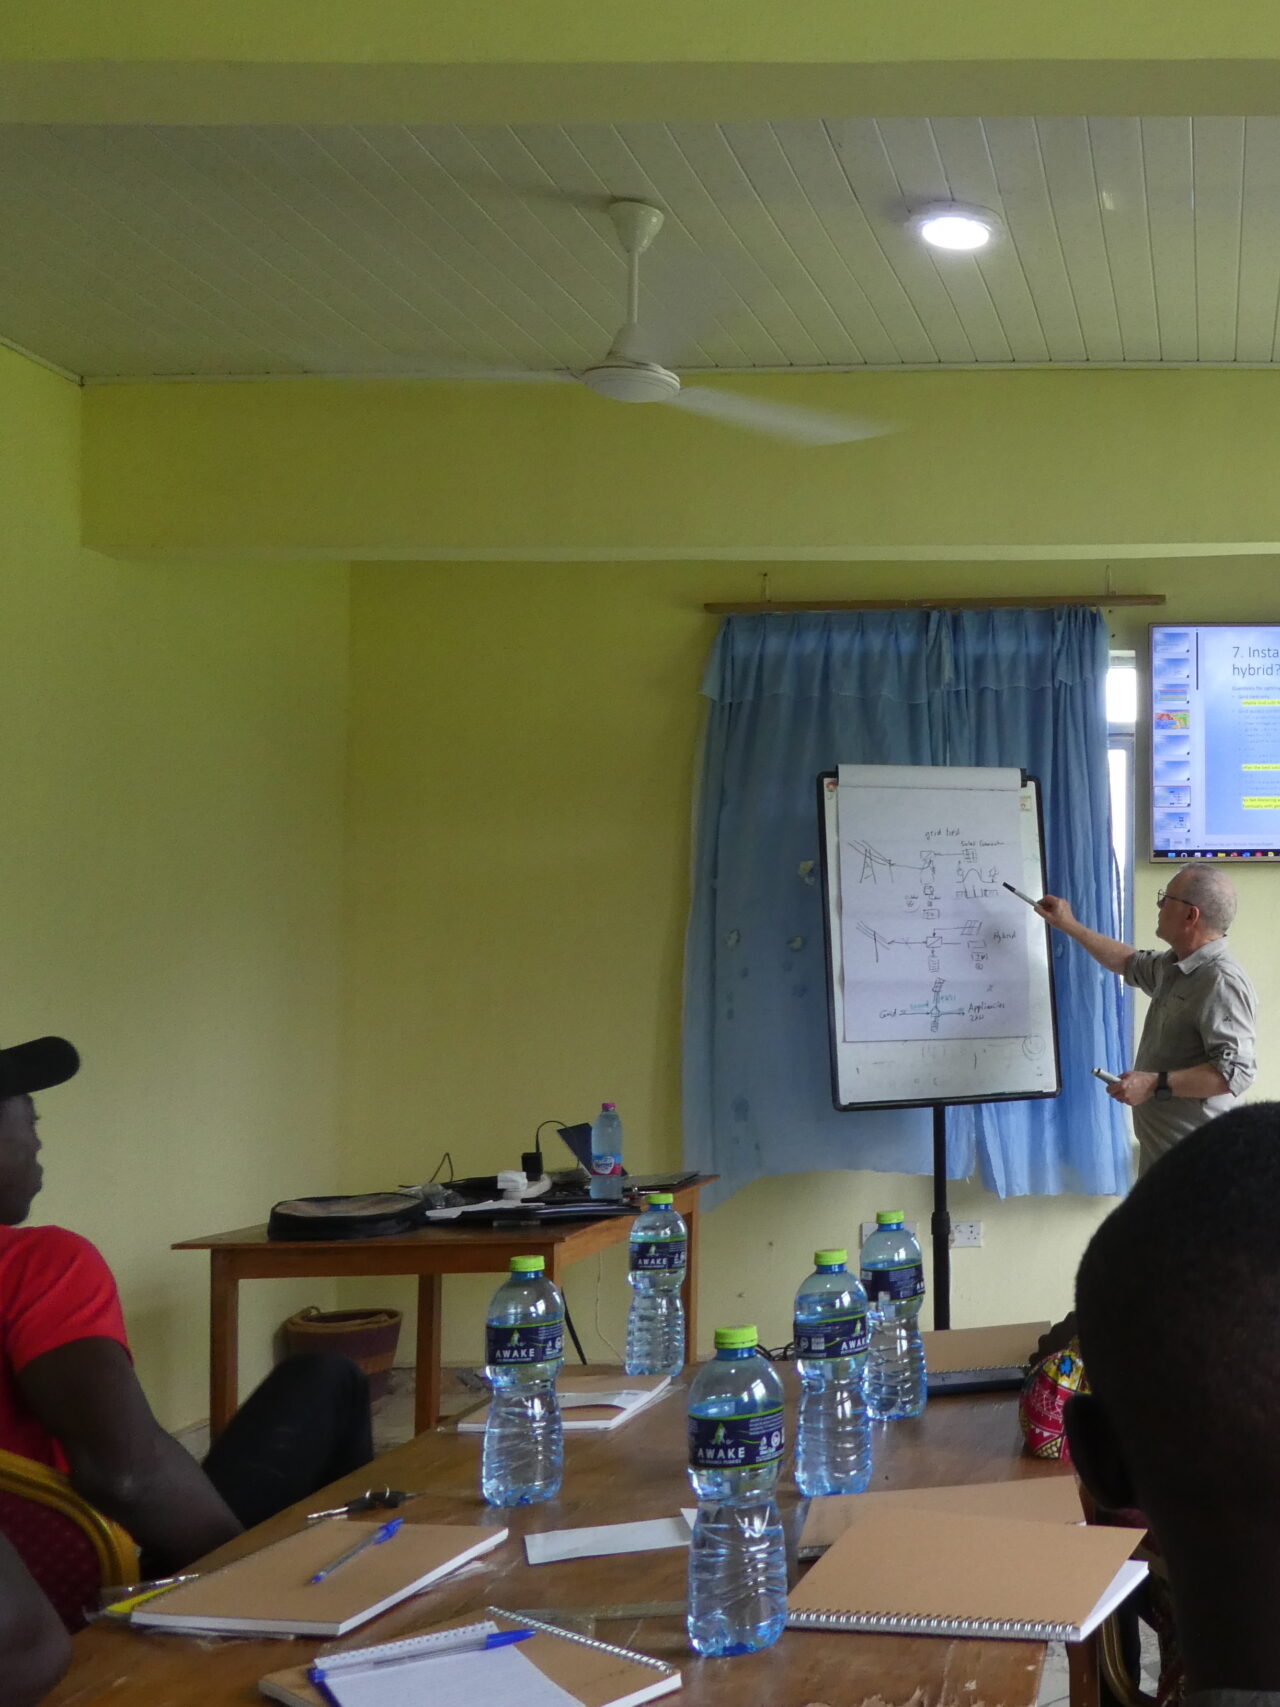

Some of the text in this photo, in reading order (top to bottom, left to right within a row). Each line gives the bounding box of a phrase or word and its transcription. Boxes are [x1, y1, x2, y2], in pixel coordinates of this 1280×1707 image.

[1231, 646, 1245, 659] 7.
[495, 1348, 535, 1358] AWAKE
[697, 1447, 746, 1459] AWAKE
